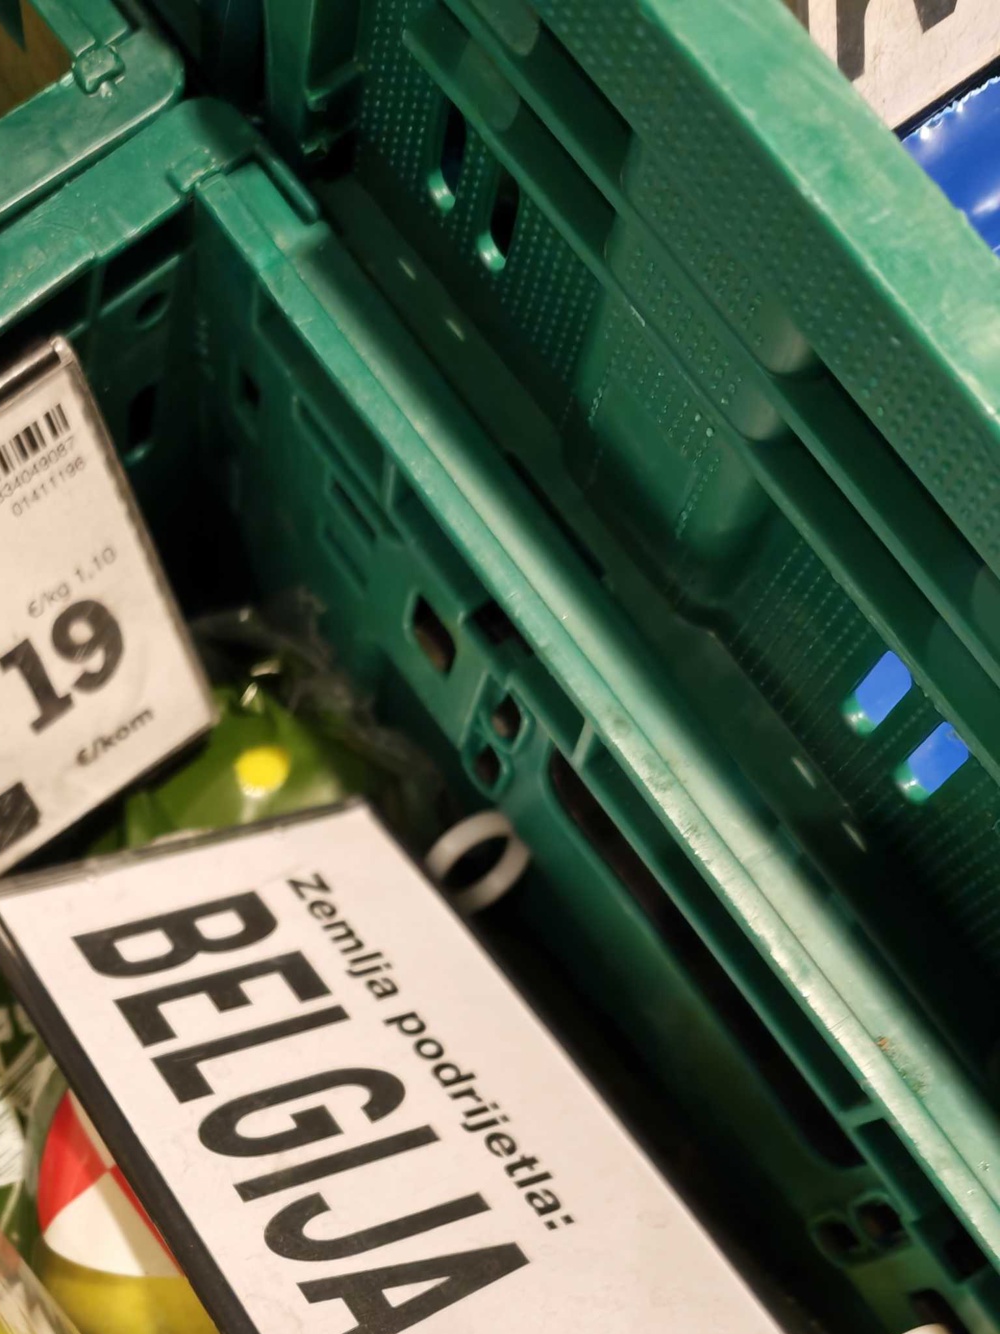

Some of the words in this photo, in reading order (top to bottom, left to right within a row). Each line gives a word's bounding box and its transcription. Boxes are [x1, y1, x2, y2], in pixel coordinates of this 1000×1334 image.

[28, 582, 71, 617] €/kg
[75, 546, 117, 583] 1,10
[75, 707, 155, 767] €/kom
[288, 872, 399, 1000] Zemlja
[383, 1010, 576, 1231] podrijetla:
